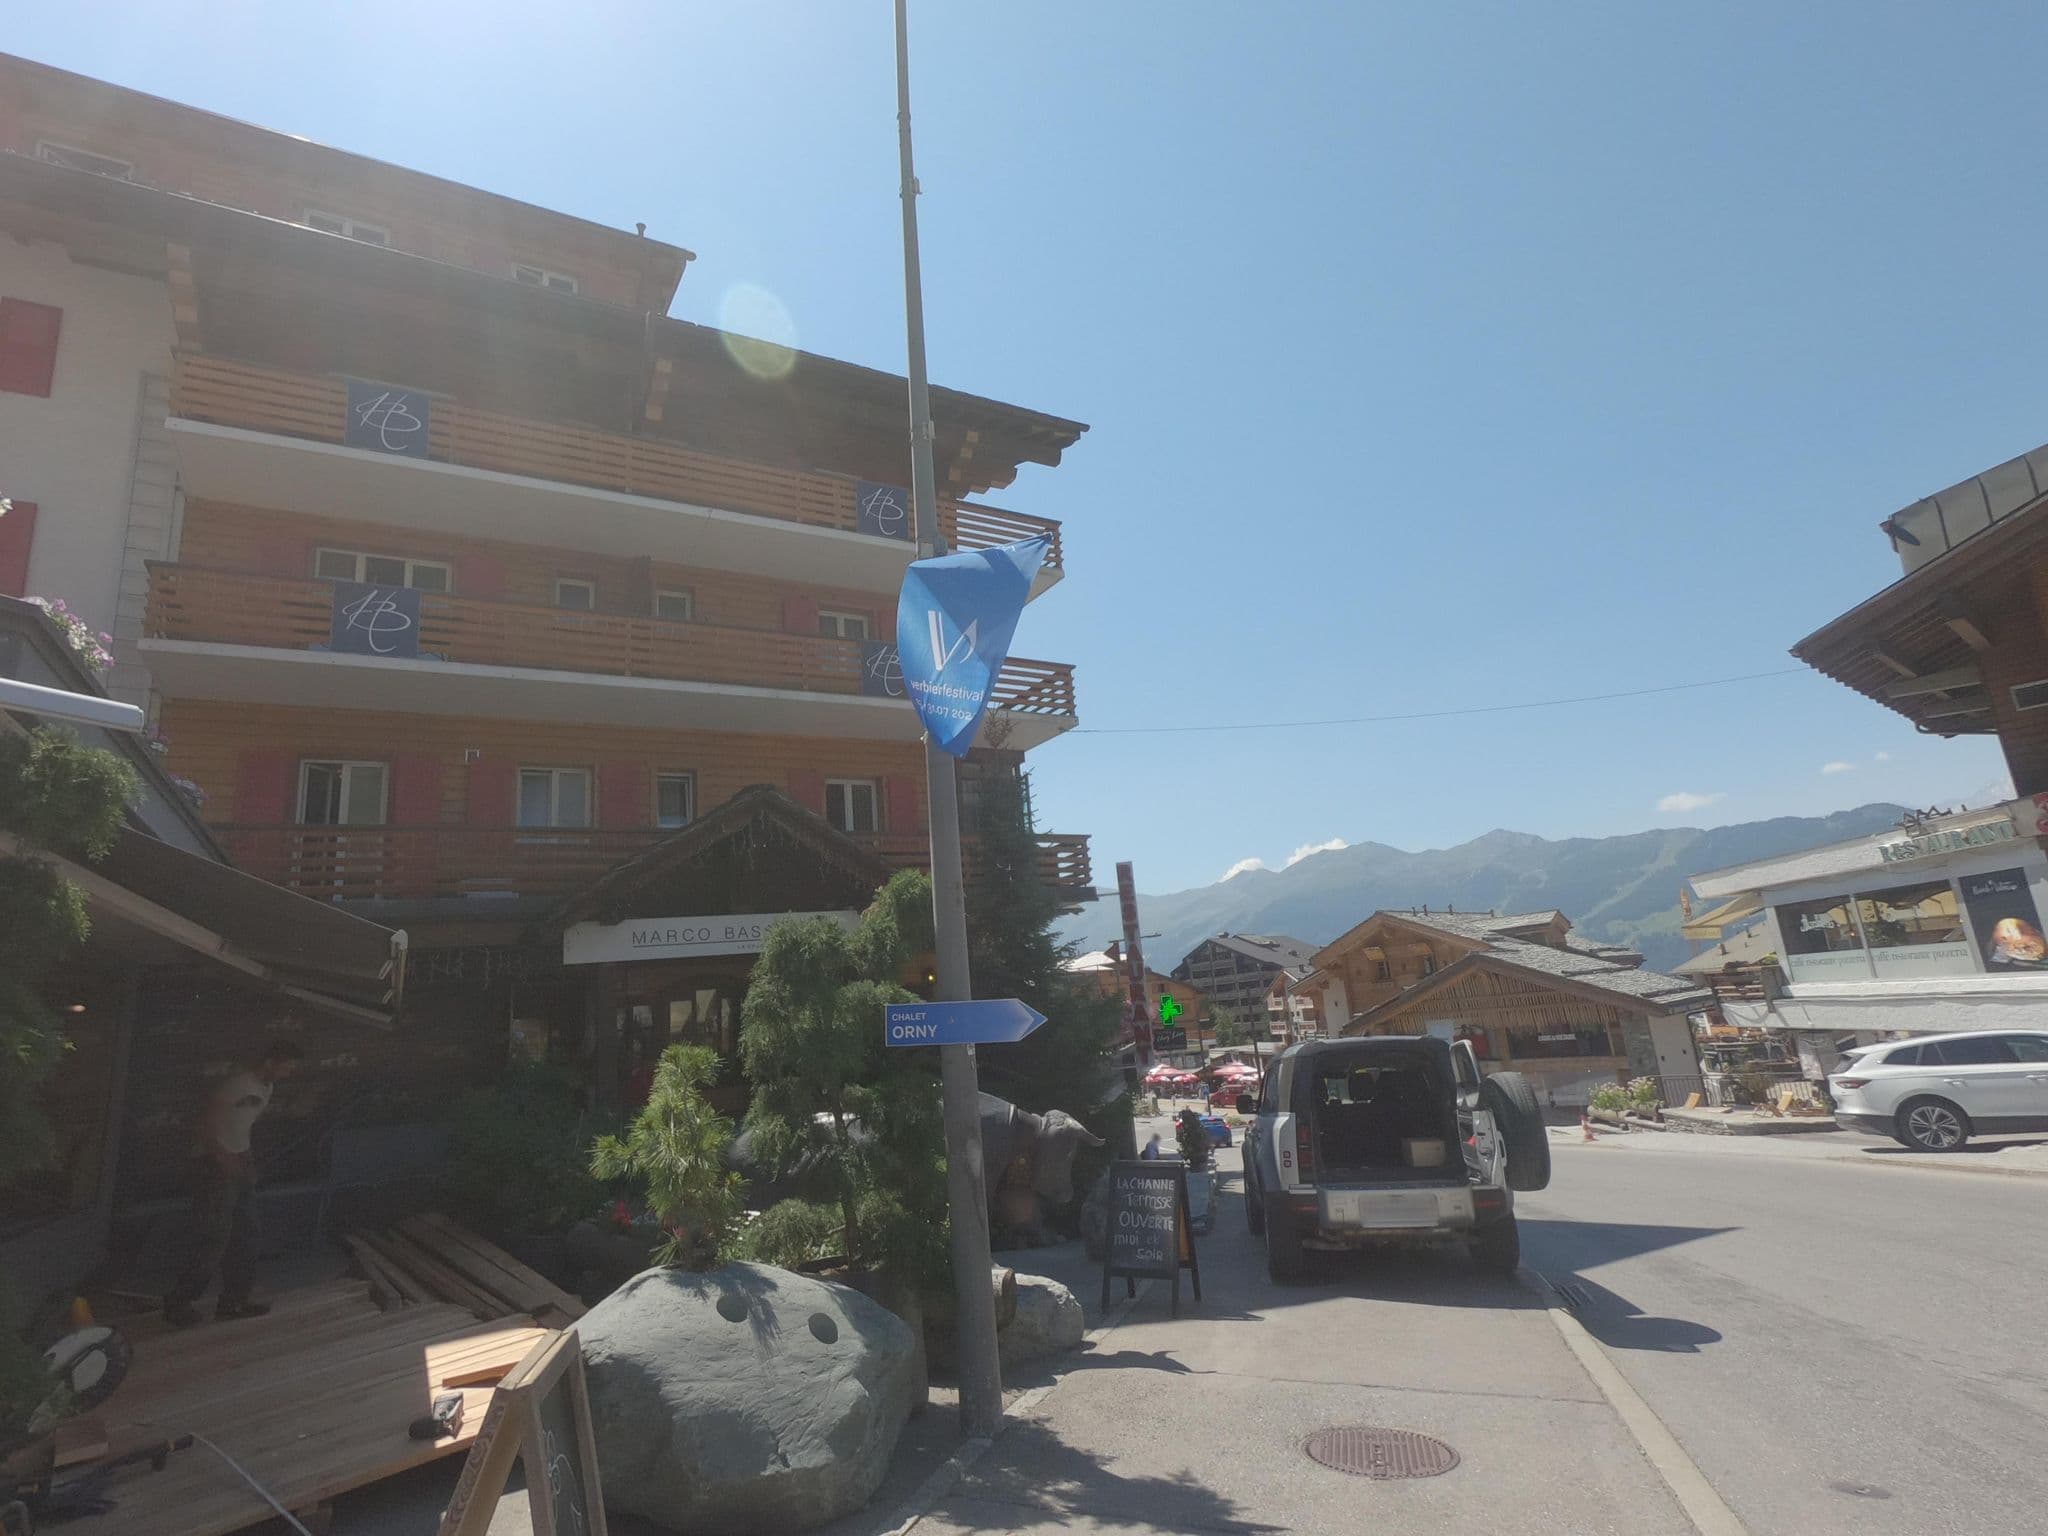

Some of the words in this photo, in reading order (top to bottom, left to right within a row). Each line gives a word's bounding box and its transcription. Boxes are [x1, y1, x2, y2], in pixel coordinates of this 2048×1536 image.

[910, 680, 985, 702] verbierfestival
[1879, 820, 2016, 864] RESTAURANT
[632, 927, 711, 945] MARCO
[891, 1012, 927, 1022] CHALET
[892, 1024, 938, 1040] ORNY
